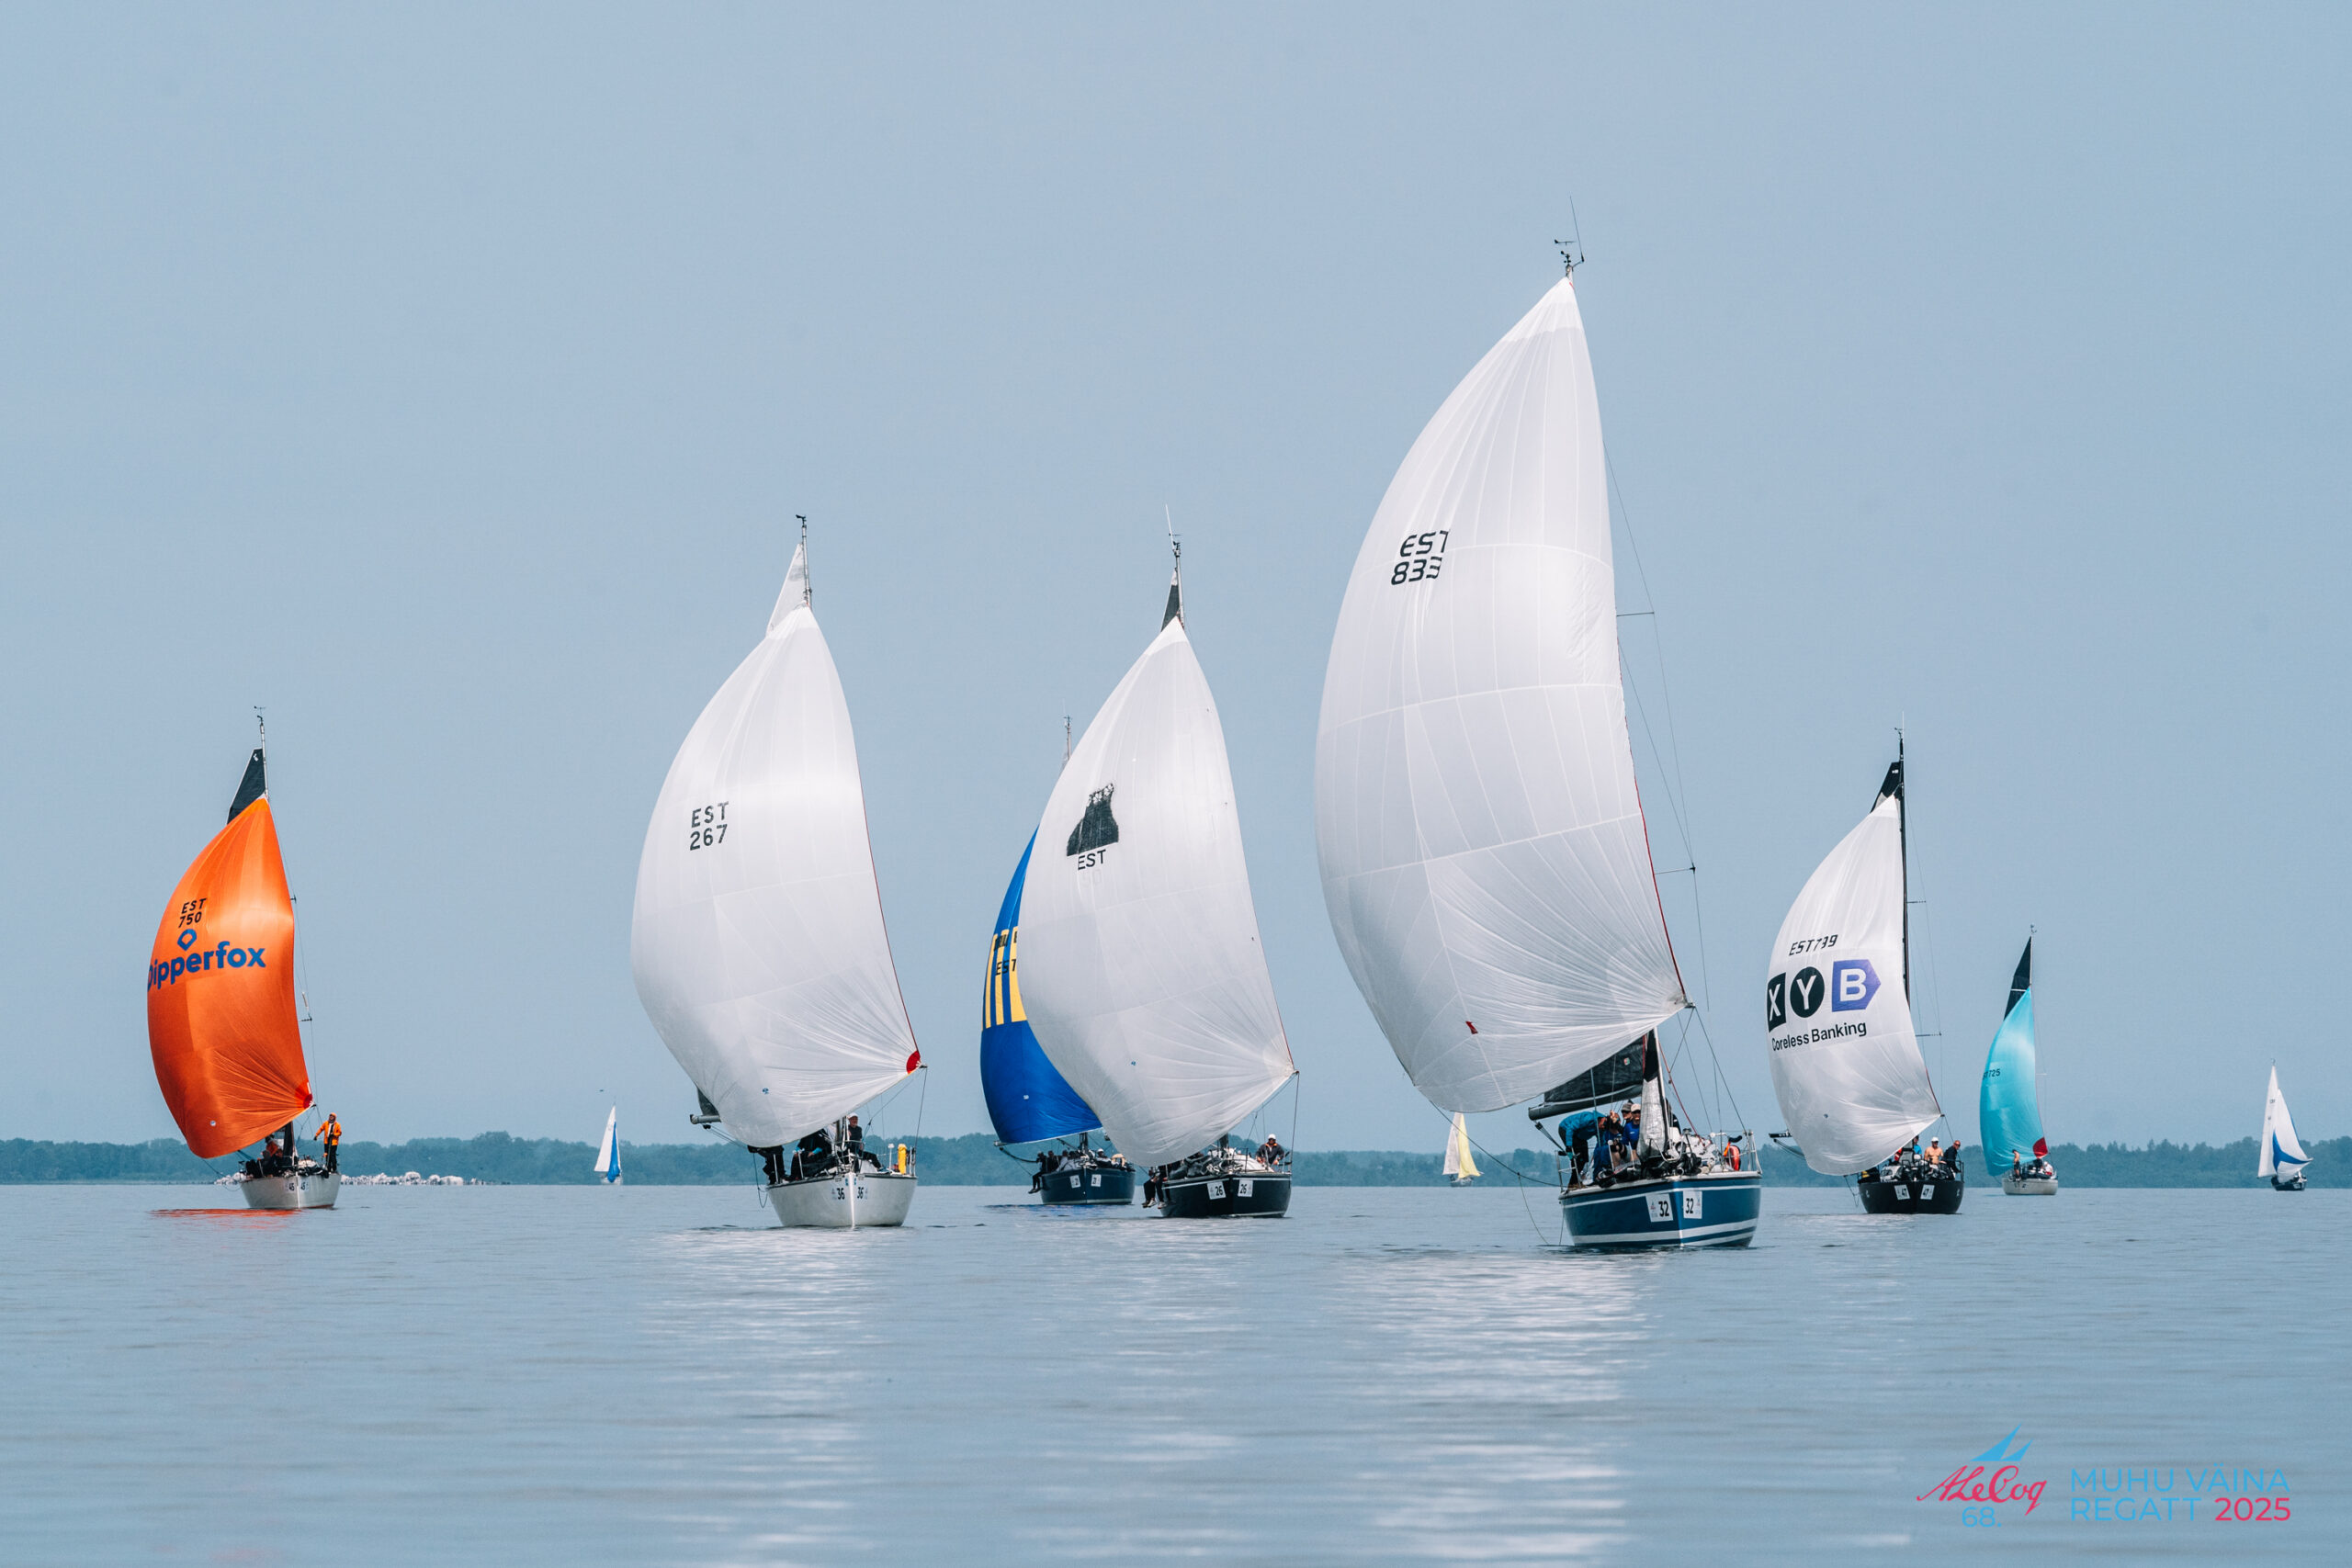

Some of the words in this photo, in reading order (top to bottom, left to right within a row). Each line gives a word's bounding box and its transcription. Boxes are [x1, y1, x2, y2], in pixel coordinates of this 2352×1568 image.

[1400, 530, 1449, 558] EST
[1391, 557, 1442, 585] 833
[691, 801, 729, 828] EST
[690, 823, 728, 851] 267
[1078, 849, 1106, 870] EST
[182, 897, 207, 914] EST
[178, 911, 202, 928] 750
[1771, 1033, 1810, 1052] Coreless
[1811, 1021, 1867, 1043] Banking
[836, 1188, 845, 1200] 36
[857, 1187, 865, 1199] 36
[1215, 1185, 1223, 1196] 26
[1239, 1184, 1248, 1194] 26
[1658, 1200, 1670, 1217] 32
[1685, 1197, 1694, 1214] 32
